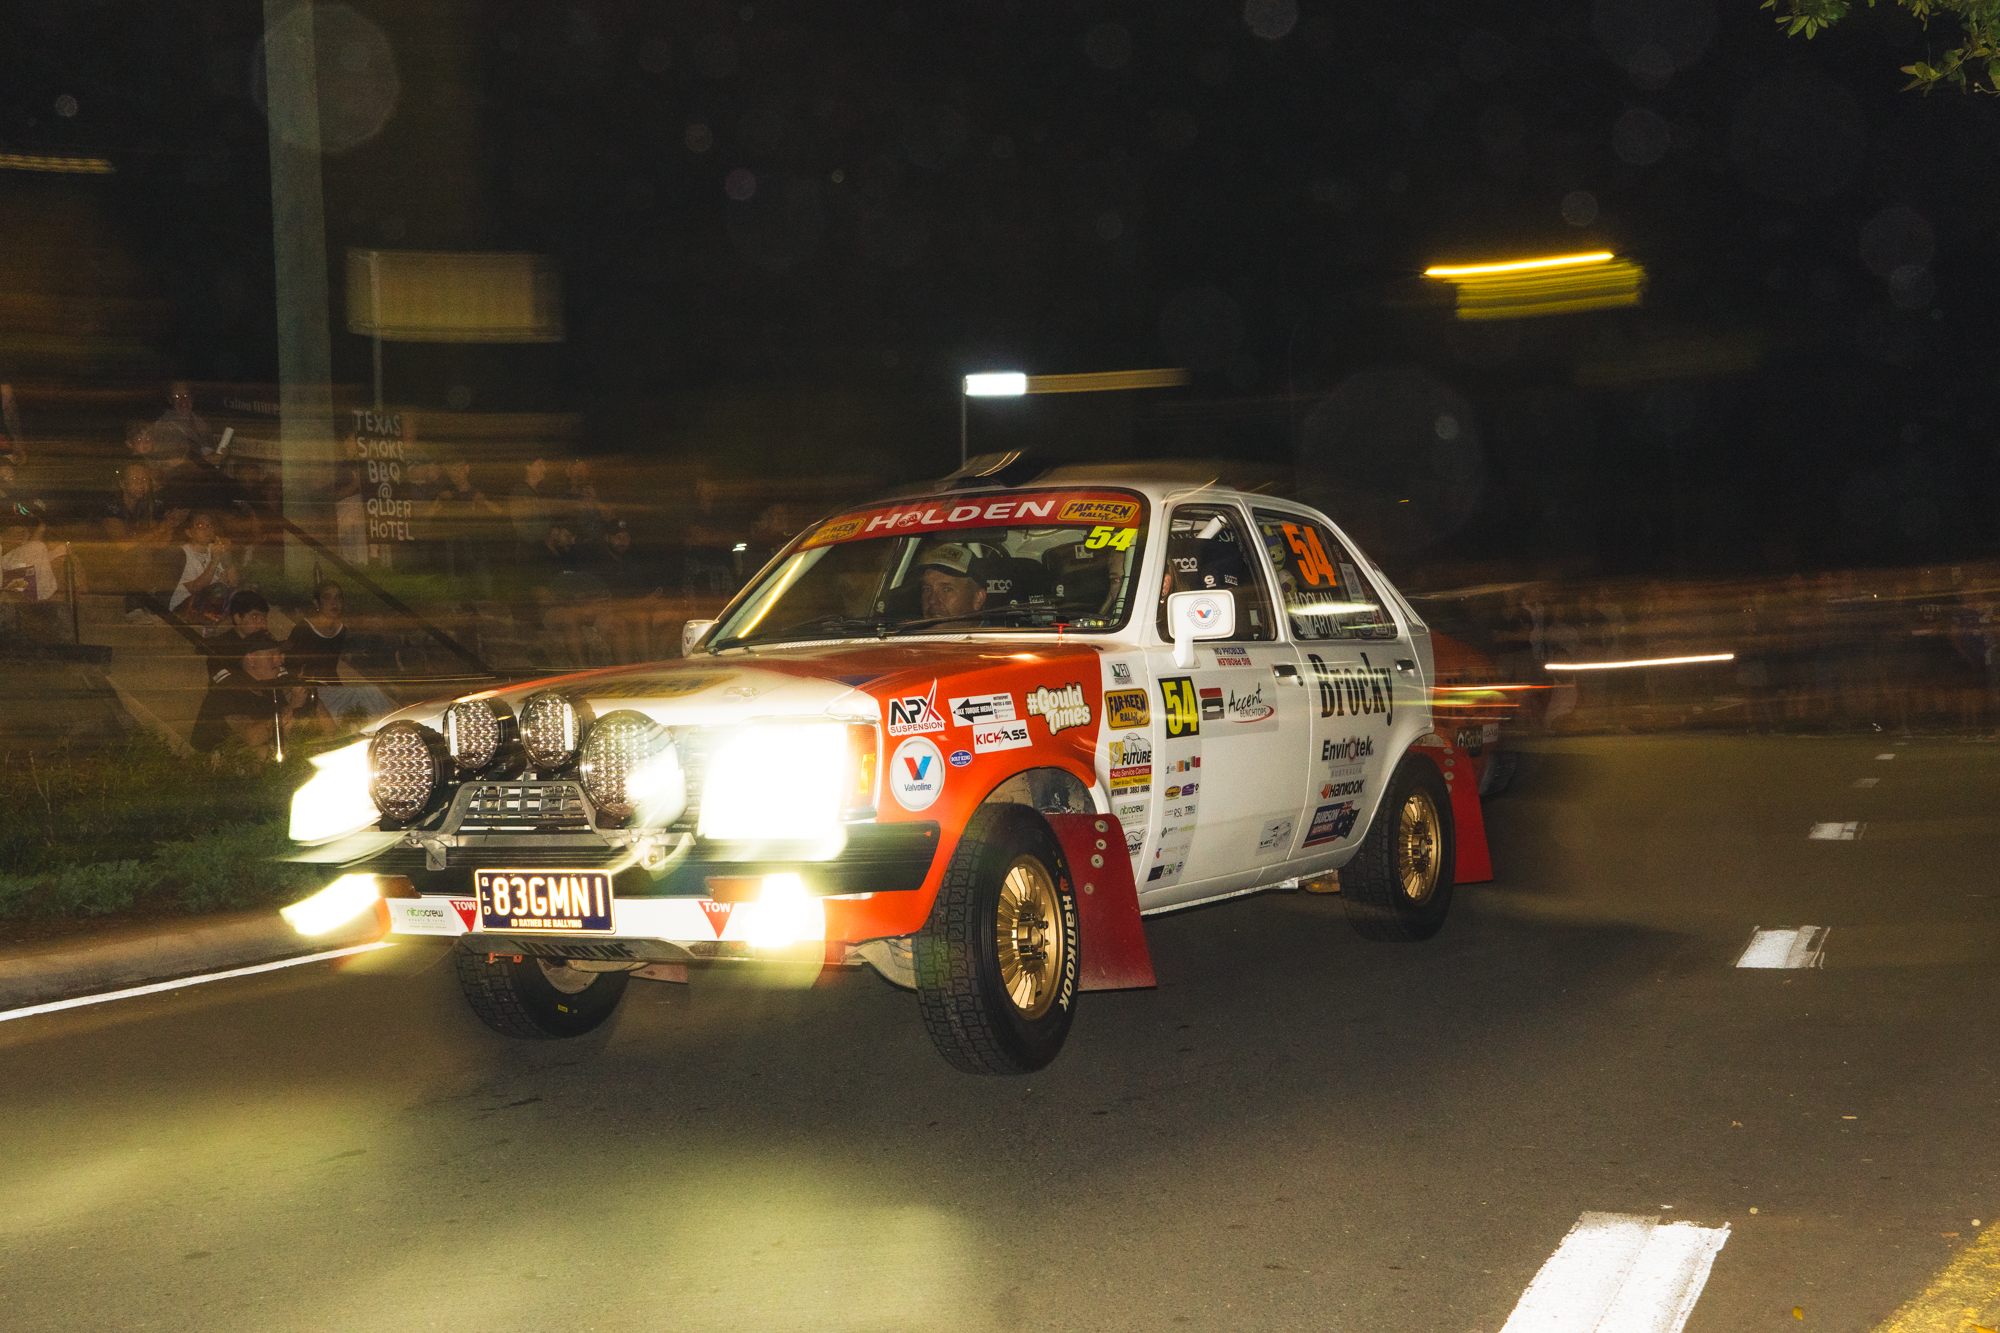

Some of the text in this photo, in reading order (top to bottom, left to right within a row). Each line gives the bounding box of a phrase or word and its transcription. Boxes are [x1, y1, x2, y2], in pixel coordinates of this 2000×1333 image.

[353, 410, 401, 437] TEXAS
[357, 436, 405, 460] SMOKE
[367, 459, 401, 485] BBQ
[378, 482, 392, 499] @
[1065, 502, 1132, 516] FAR-KEEN
[370, 519, 415, 541] HOTEL
[1085, 525, 1138, 551] 54
[1281, 523, 1337, 586] 54
[1212, 647, 1247, 655] NO PROBLEM
[1228, 682, 1263, 713] Accent
[1307, 652, 1393, 726] Brocky
[890, 677, 941, 726] APX
[1026, 684, 1084, 715] #Gould
[1108, 693, 1147, 722] FAR-KEEN
[1162, 680, 1198, 735] 54
[965, 706, 980, 715] TORQUE
[980, 705, 993, 713] MEDIA
[1240, 707, 1267, 718] BENCHTOPS
[890, 722, 943, 734] SUSPENSION
[1046, 706, 1091, 734] Times
[975, 727, 1027, 746] KICKASS
[1121, 750, 1151, 765] FUTURE
[1321, 736, 1373, 761] Envirotek
[1111, 767, 1150, 778] Auto Service Centres
[1331, 766, 1363, 777] AUSTRALIA
[904, 782, 933, 792] Valvoline
[1111, 787, 1128, 797] WYNNUM
[481, 876, 492, 916] QLD
[406, 907, 444, 918] nitrocrew
[453, 901, 477, 911] TOW
[702, 902, 731, 913] TOW
[519, 918, 543, 928] RATHER
[543, 919, 553, 928] BE
[553, 919, 583, 928] RALLYING
